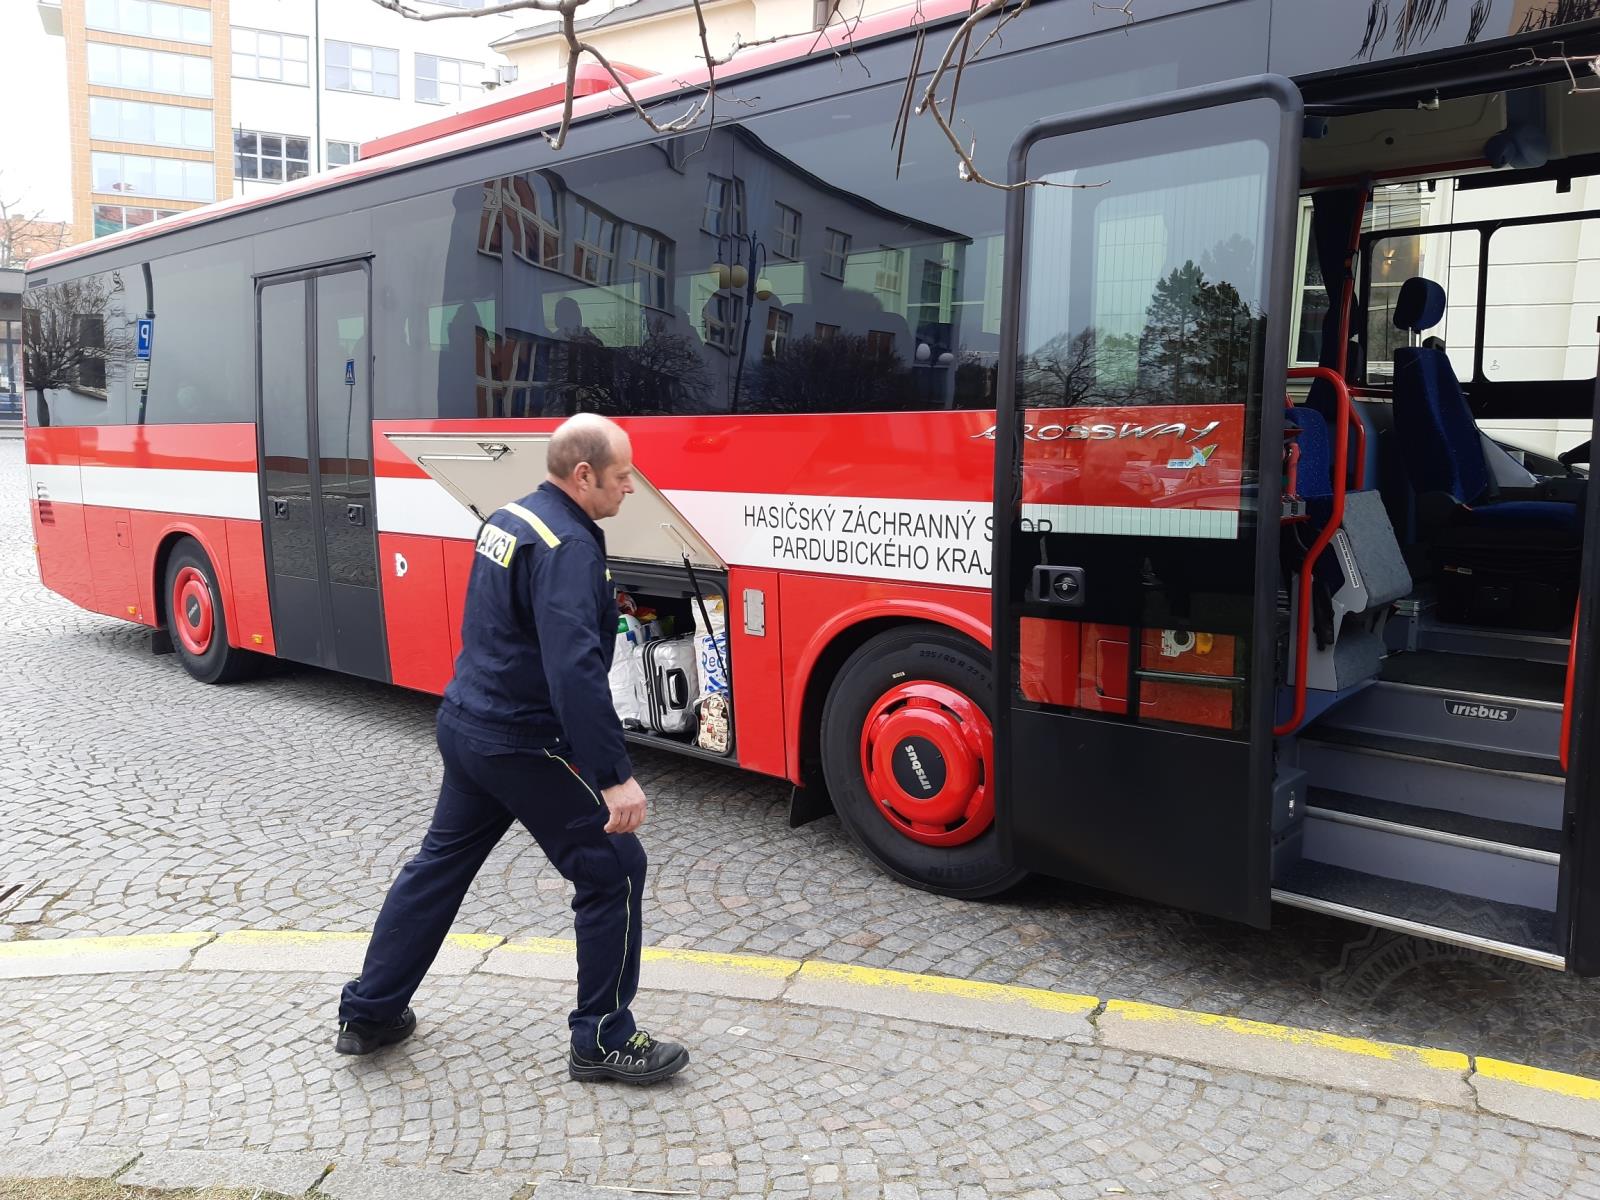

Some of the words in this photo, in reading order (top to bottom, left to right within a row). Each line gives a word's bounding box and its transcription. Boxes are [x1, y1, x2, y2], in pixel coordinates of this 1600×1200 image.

[743, 501, 837, 531] HASIČSKÝ
[842, 504, 976, 541] ZÁCHRANNÝ
[773, 535, 929, 571] PARDUBICKÉHO
[936, 547, 994, 577] KRAJ
[1452, 704, 1508, 721] irisbus
[905, 744, 932, 791] irisbus
